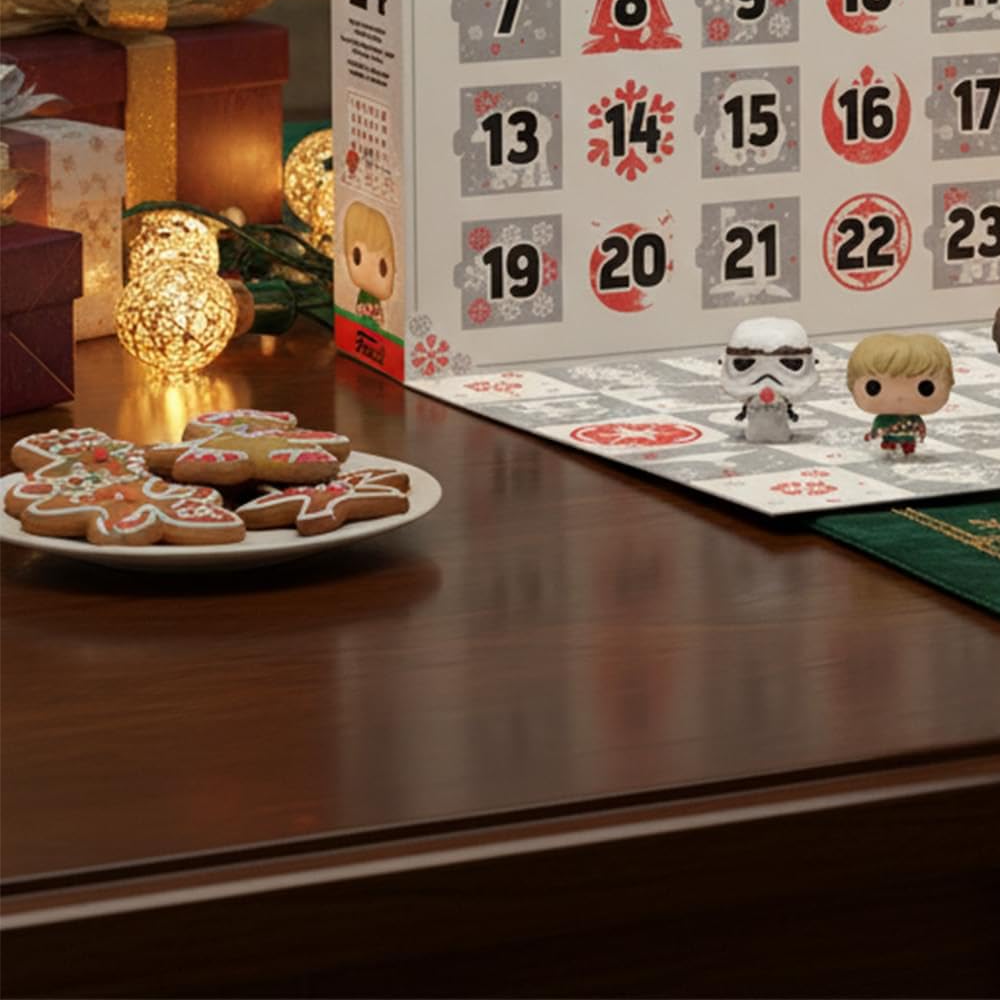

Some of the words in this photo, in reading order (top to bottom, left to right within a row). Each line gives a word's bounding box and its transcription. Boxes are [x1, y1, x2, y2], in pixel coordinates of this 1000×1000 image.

[481, 110, 539, 166] 13
[605, 102, 661, 157] 14
[723, 94, 778, 149] 15
[838, 86, 893, 140] 16
[599, 233, 666, 290] 20
[725, 224, 776, 280] 21
[837, 215, 895, 270] 22
[483, 244, 540, 299] 19
